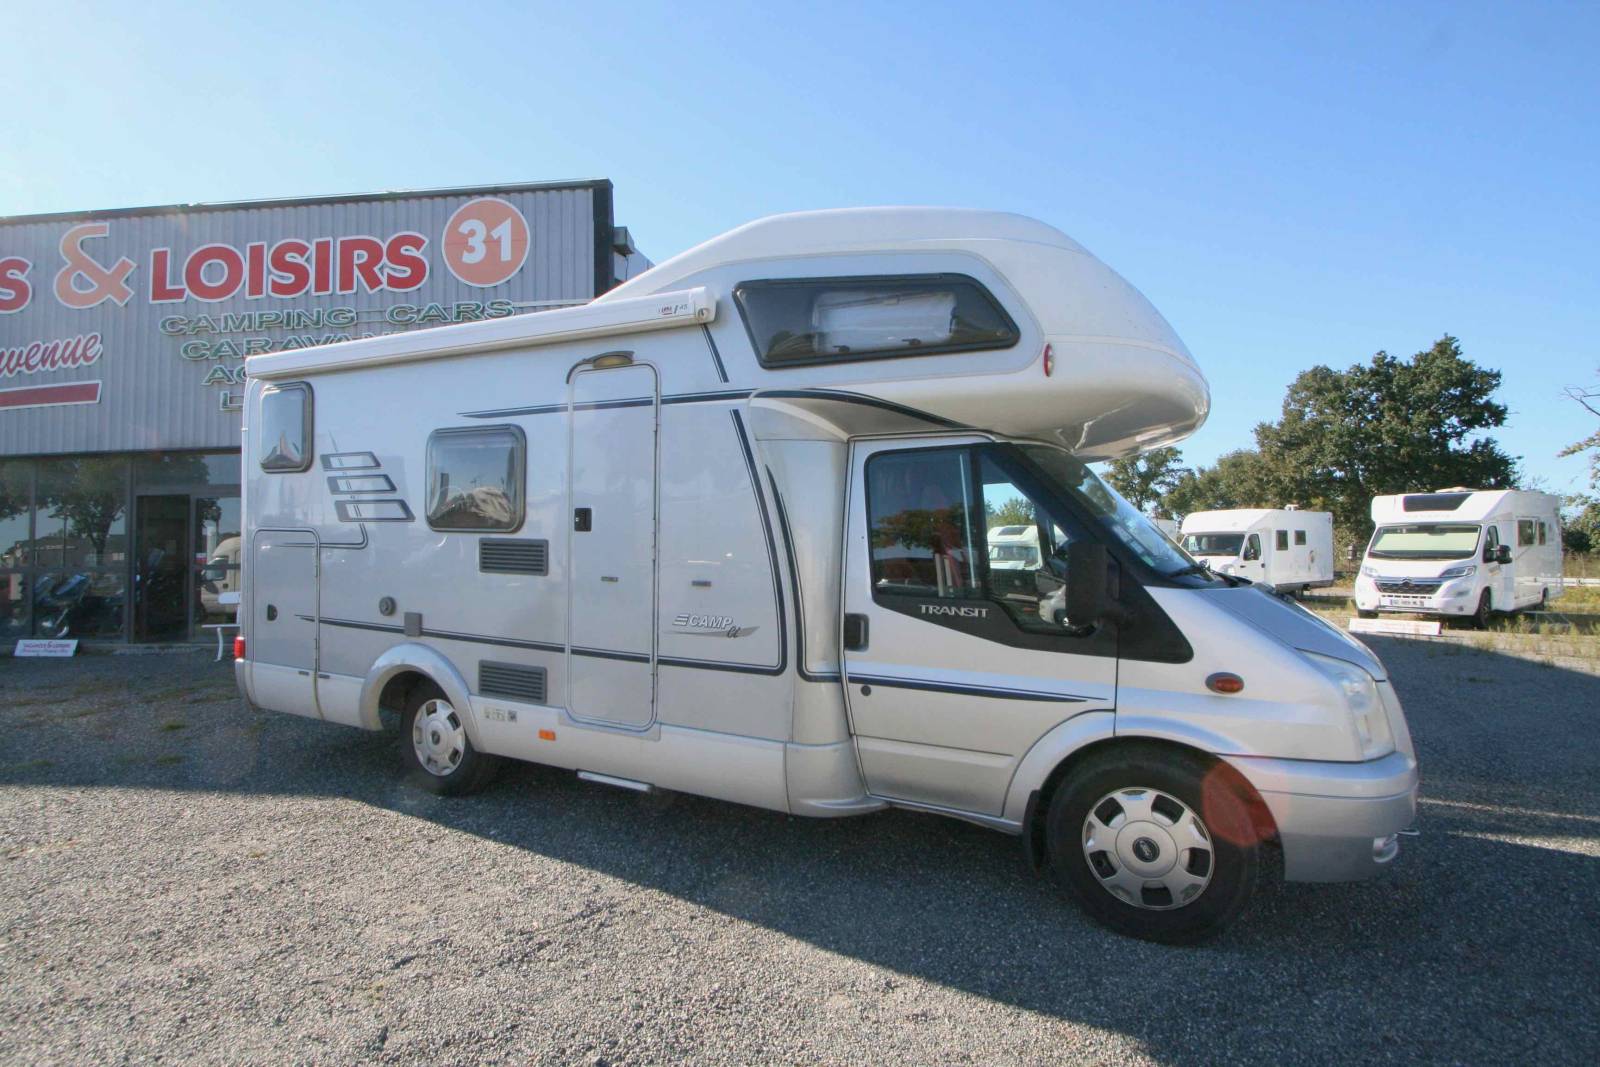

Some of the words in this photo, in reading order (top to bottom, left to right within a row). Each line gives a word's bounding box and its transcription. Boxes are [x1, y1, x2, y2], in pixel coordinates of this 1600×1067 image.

[53, 222, 137, 309] &
[149, 231, 430, 304] LOISIRS
[458, 216, 513, 265] 31
[159, 307, 357, 335] CAMPING
[386, 299, 515, 324] CARS
[919, 604, 989, 618] TRANSIT
